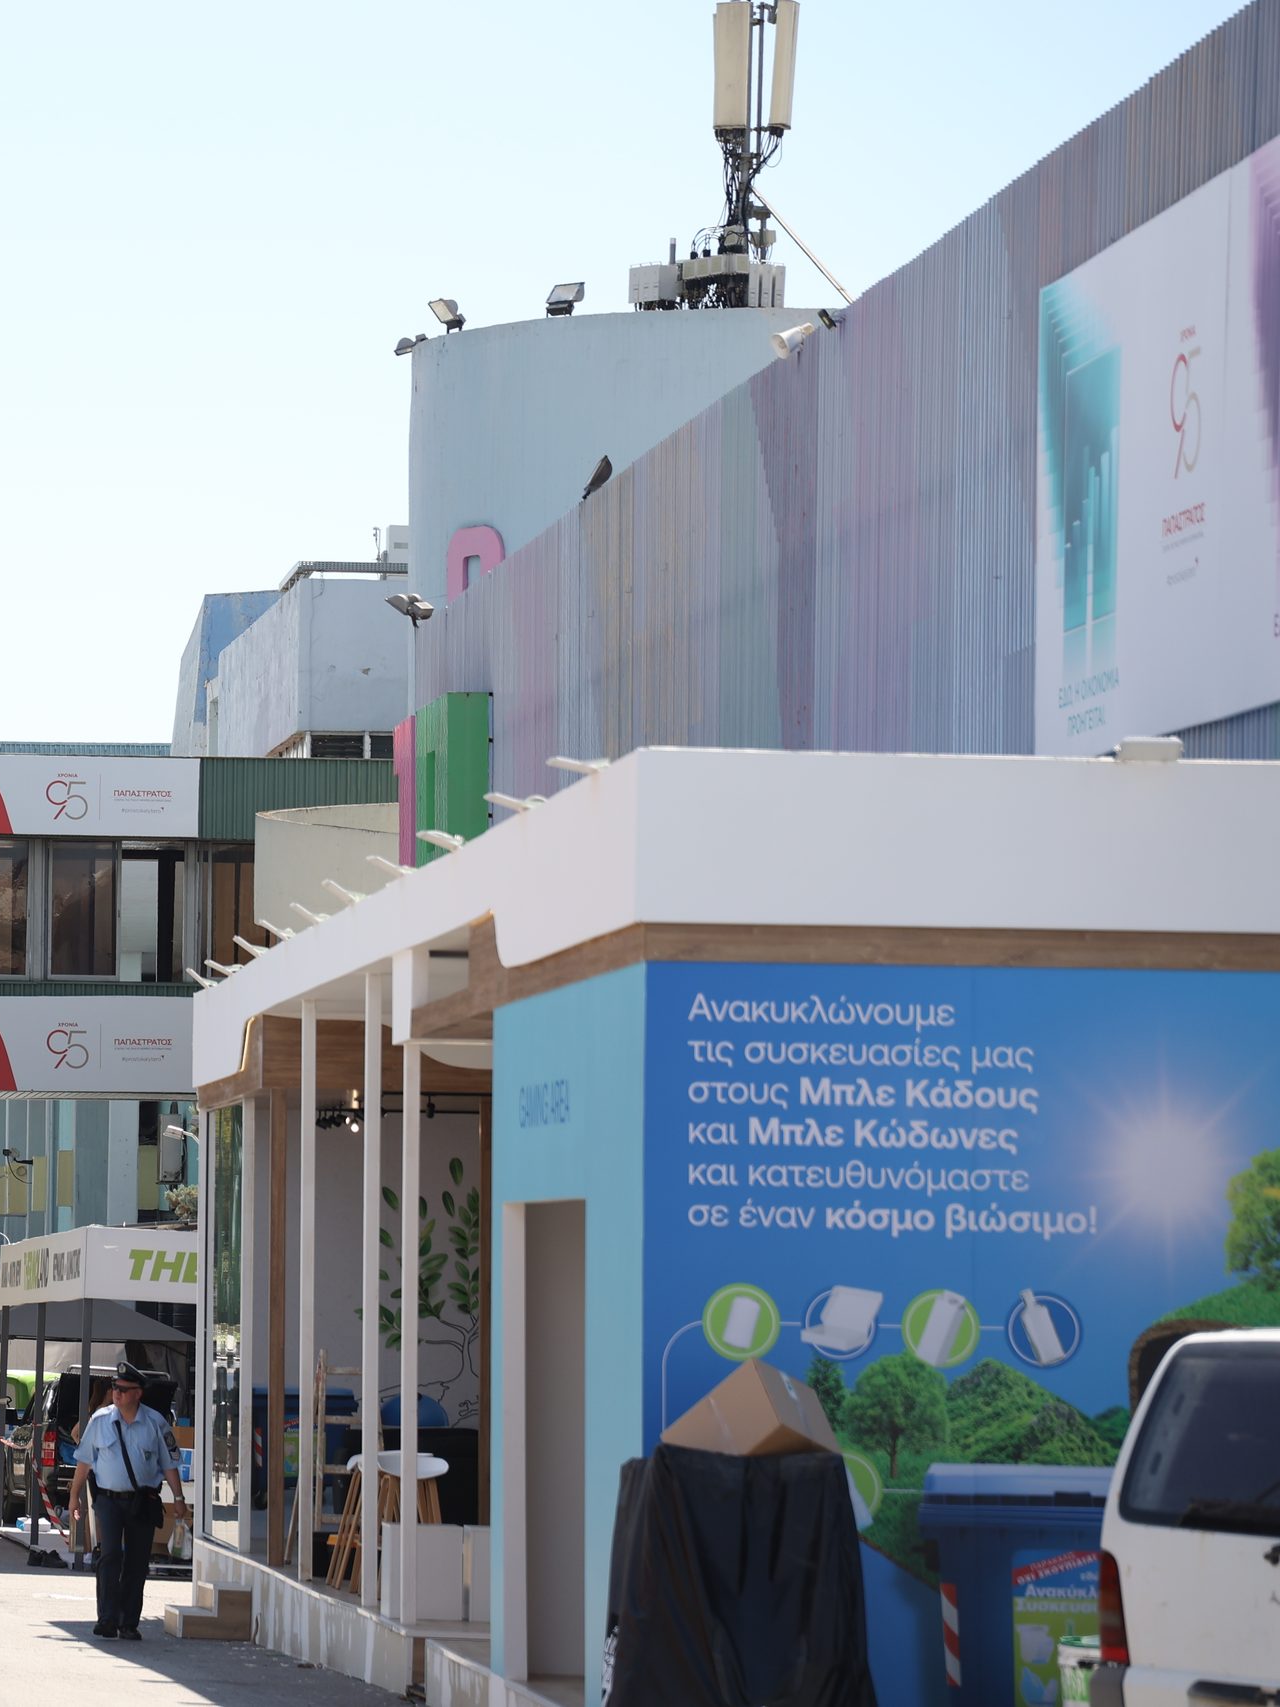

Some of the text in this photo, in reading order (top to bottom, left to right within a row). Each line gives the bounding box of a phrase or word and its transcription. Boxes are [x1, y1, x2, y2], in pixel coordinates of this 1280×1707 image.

[1171, 346, 1201, 479] 95
[46, 780, 88, 820] 95
[113, 789, 172, 798] ΠΑΠΑΣΤΡΑΤΟΣ
[687, 992, 956, 1032] Ανακυκλώνουμε
[47, 1029, 89, 1069] 95
[113, 1038, 173, 1046] ΠΑΠΑΣΤΡΑΤΟΣ
[687, 1037, 1035, 1073] τις συσκευασίες μας
[687, 1077, 1039, 1114] στους Μπλε Κάδους
[687, 1117, 1018, 1155] και Μπλε Κώδωνες
[687, 1160, 1030, 1197] και κατευθυνόμαστε
[687, 1198, 1098, 1240] σε έναν κόσμο βιώσιμο!
